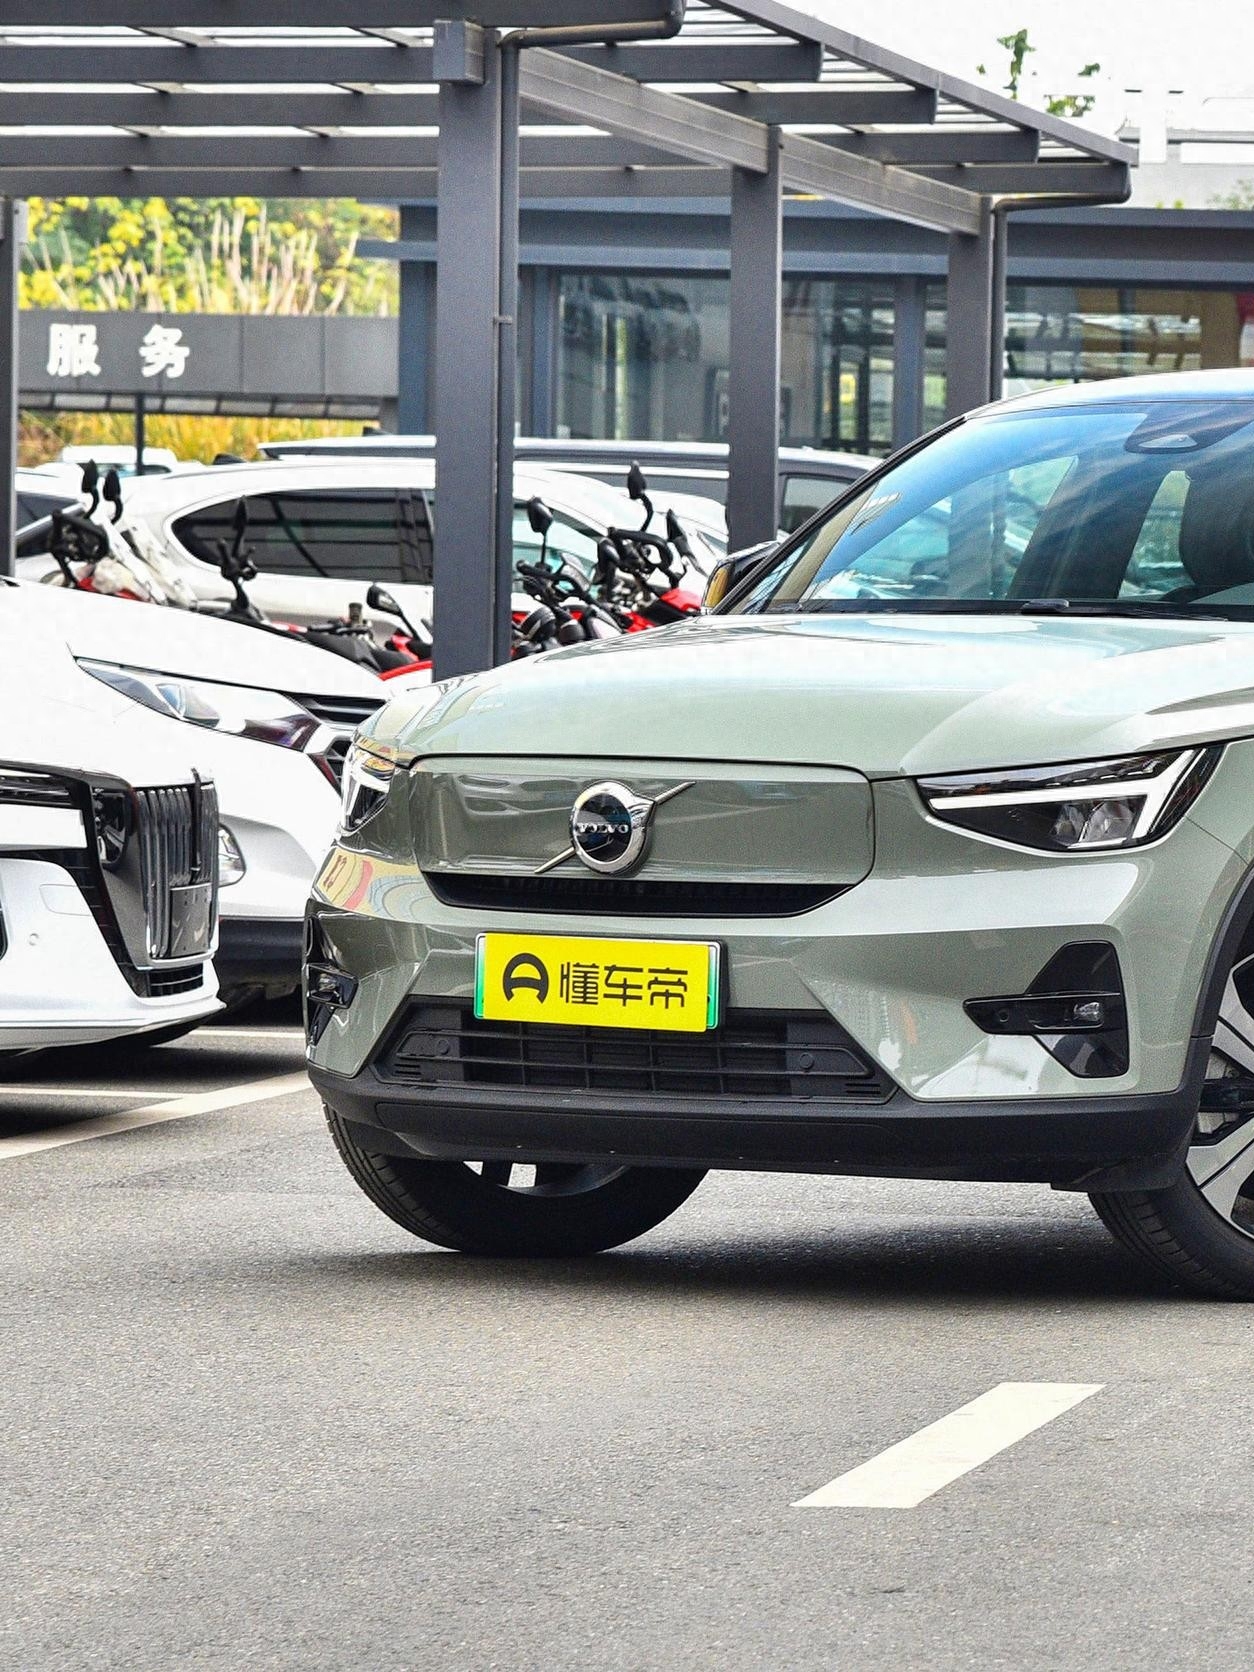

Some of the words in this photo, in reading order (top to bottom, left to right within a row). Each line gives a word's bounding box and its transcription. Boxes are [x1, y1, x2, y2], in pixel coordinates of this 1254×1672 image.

[47, 323, 190, 379] 服务
[576, 822, 629, 834] VOLVO
[559, 962, 688, 1009] 懂车帝
